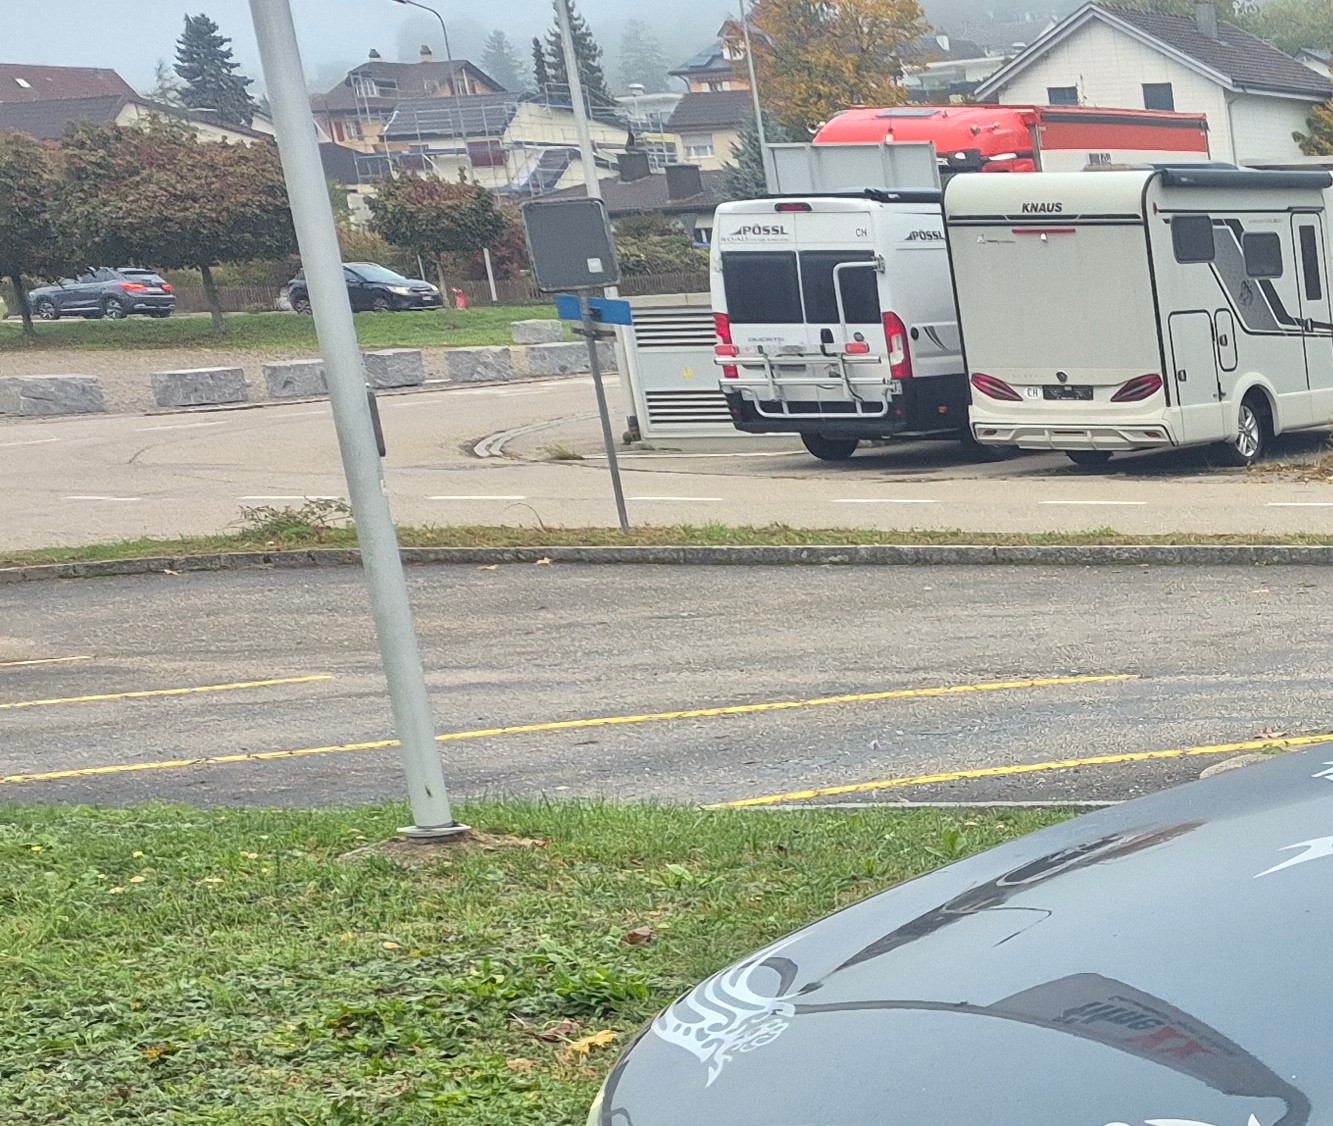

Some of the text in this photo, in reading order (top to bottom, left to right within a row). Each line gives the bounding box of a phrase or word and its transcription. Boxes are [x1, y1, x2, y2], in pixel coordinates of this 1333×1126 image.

[1021, 202, 1063, 213] KNAUS
[855, 227, 868, 238] CH
[1026, 387, 1039, 398] CH
